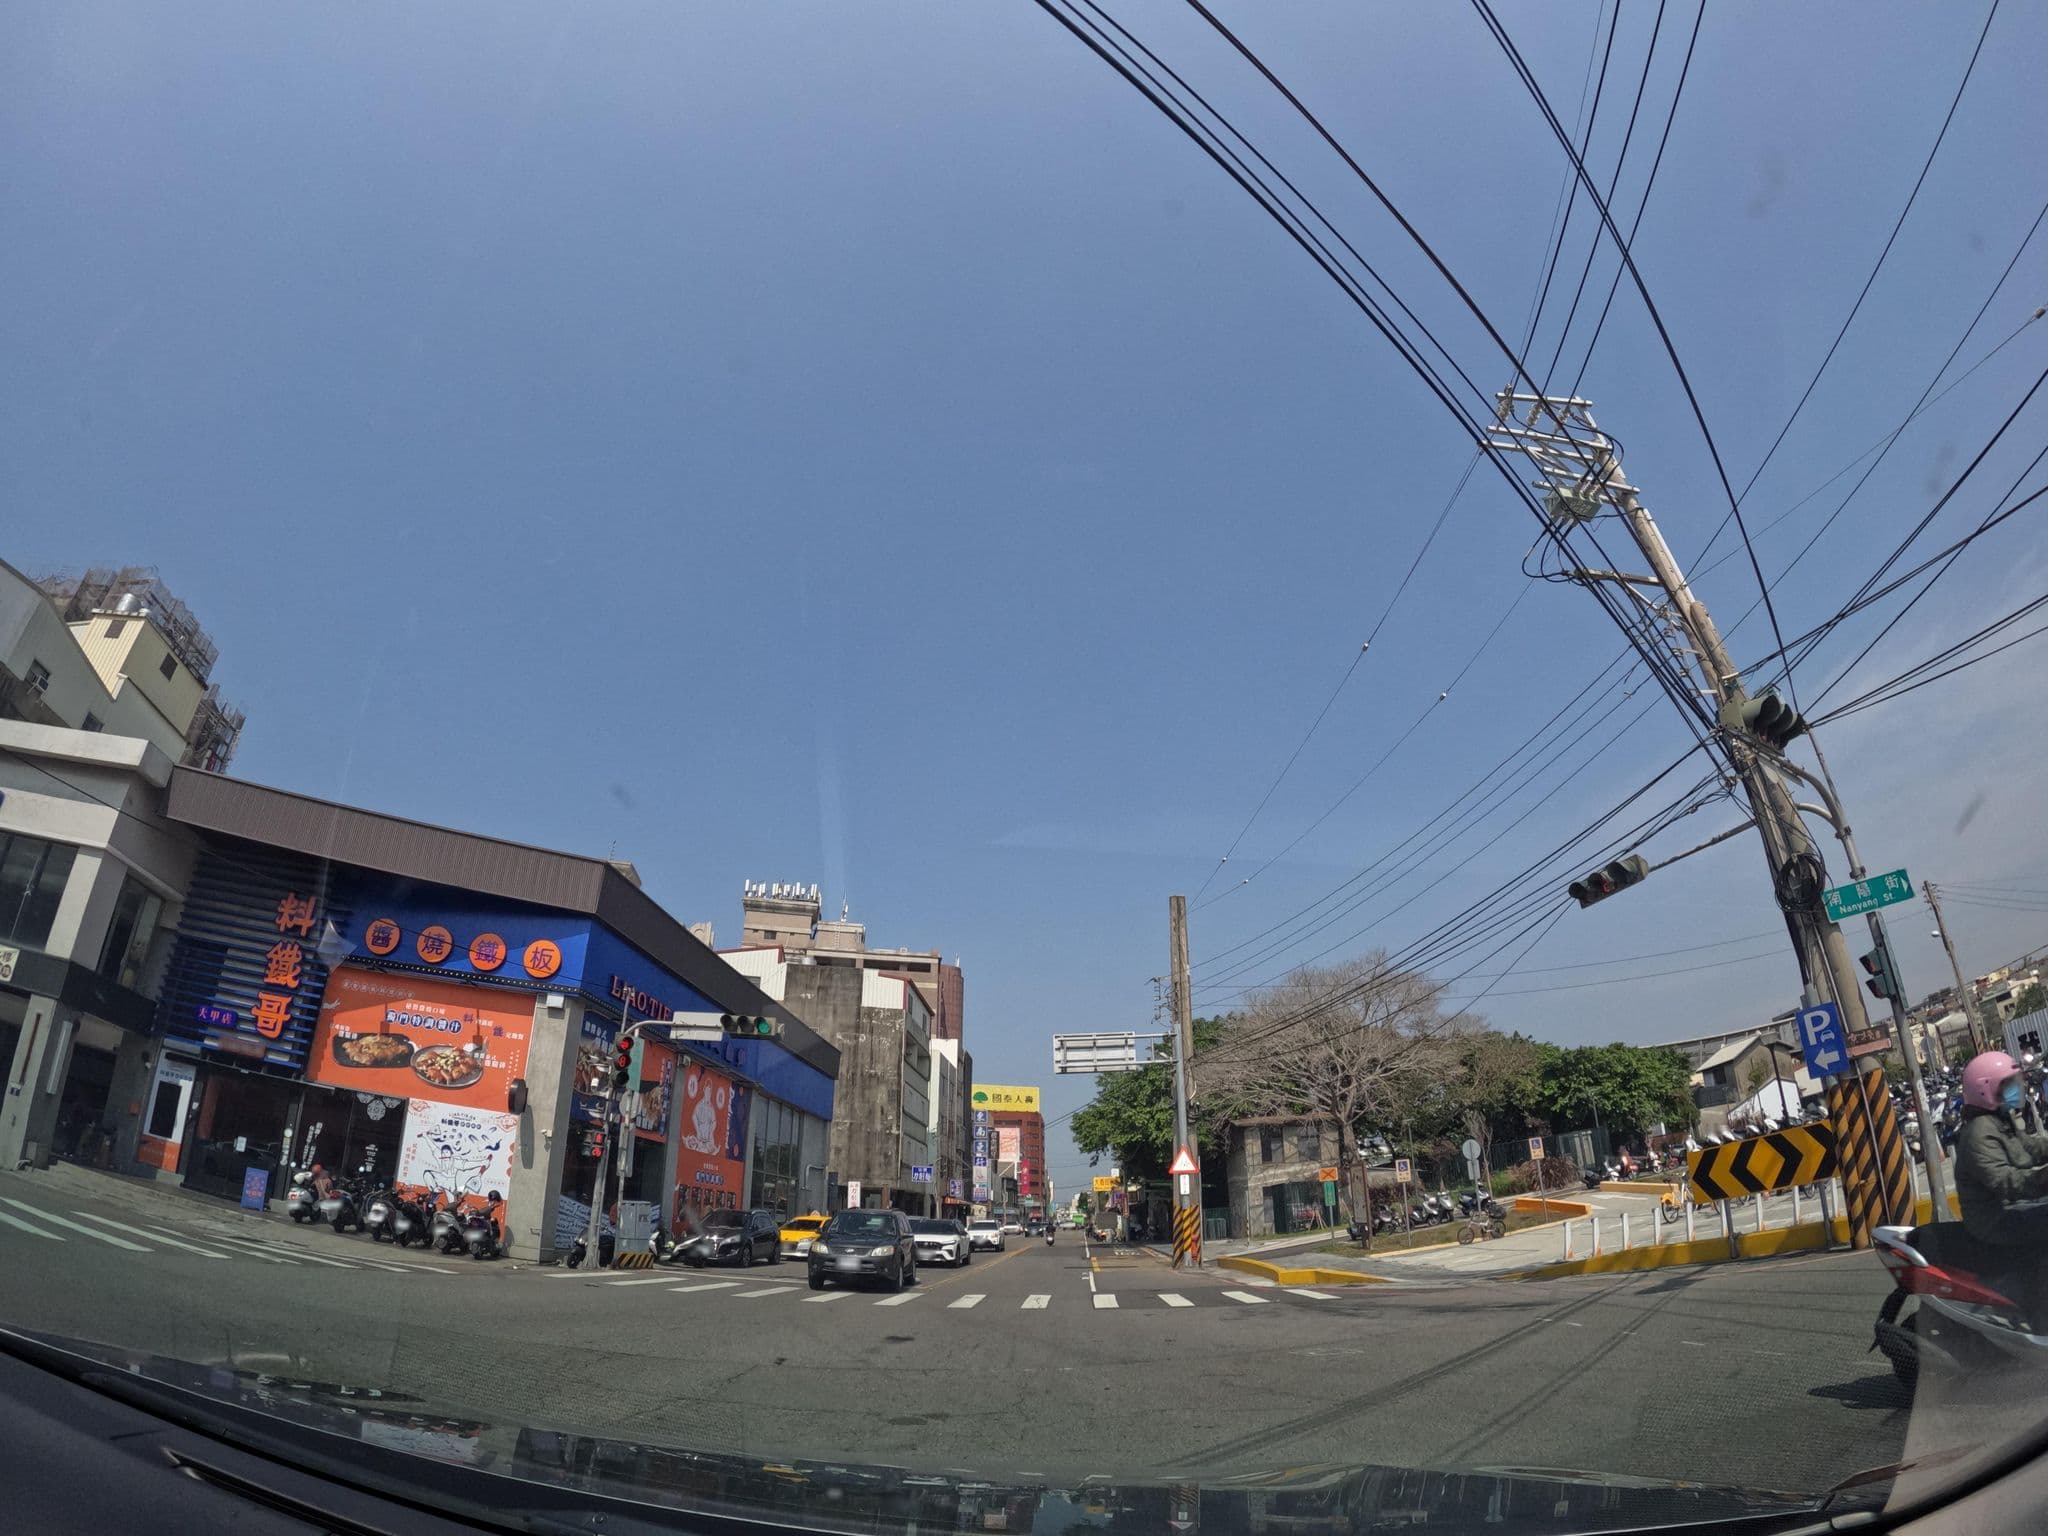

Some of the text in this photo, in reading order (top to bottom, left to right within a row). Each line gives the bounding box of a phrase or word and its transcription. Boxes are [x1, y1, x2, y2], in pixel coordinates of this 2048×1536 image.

[1827, 874, 1899, 907] 南陽街
[1839, 898, 1879, 915] Nanyang
[251, 890, 316, 1039] 料鐵哥
[369, 922, 556, 973] 醬燒鐵板
[1803, 1010, 1831, 1046] P
[991, 1093, 1034, 1105] 國泰人壽
